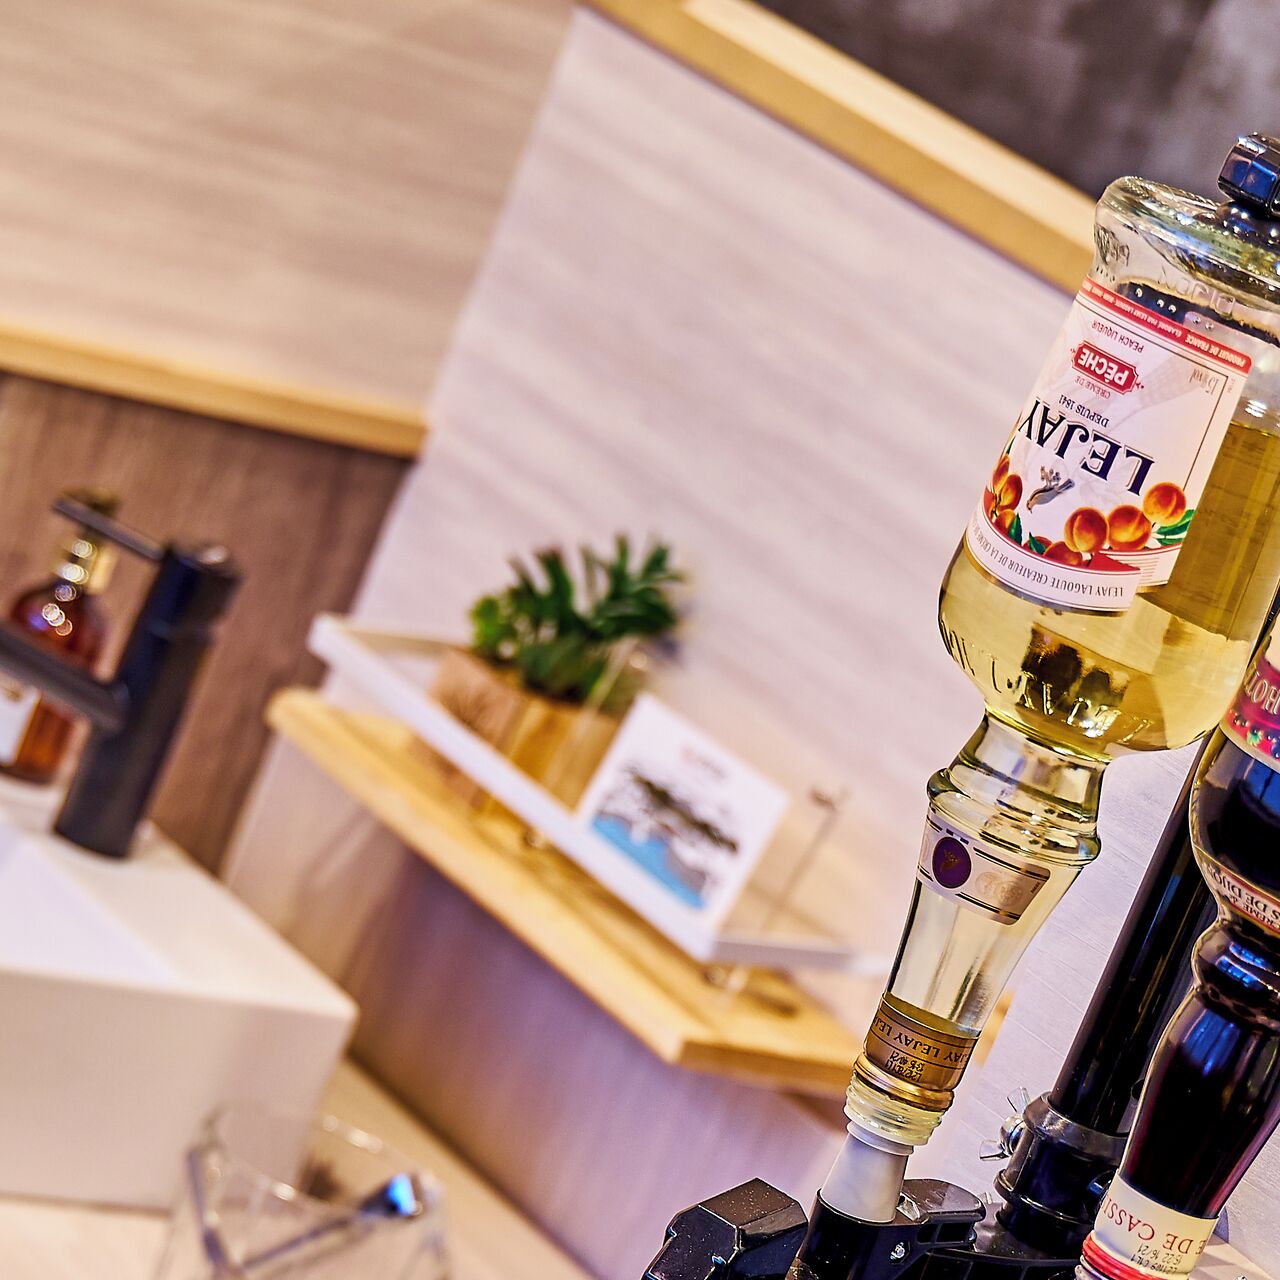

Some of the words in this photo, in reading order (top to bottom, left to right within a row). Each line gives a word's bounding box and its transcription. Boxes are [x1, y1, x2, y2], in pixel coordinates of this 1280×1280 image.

[1089, 319, 1119, 340] LIQUEUR
[1117, 333, 1145, 353] PEACH
[1183, 333, 1210, 352] FRANCE
[1207, 344, 1219, 356] DE
[1073, 347, 1131, 389] PÊCHE
[1217, 349, 1246, 368] PRODUIT
[1073, 374, 1086, 386] DE
[1056, 394, 1076, 410] 1841
[1073, 403, 1110, 428] DEPUIS
[1016, 398, 1155, 496] LEJAY
[989, 546, 999, 559] LA
[996, 553, 1008, 566] DE
[1006, 558, 1048, 585] CRÉATEUR
[1050, 577, 1092, 594] LAGOUTE
[1096, 586, 1123, 596] LEJAY
[1243, 892, 1267, 912] DE
[892, 1031, 941, 1058] LEJAY
[1100, 1195, 1157, 1242] CASSI
[1137, 1242, 1160, 1259] 16/21
[1161, 1232, 1193, 1254] DE
